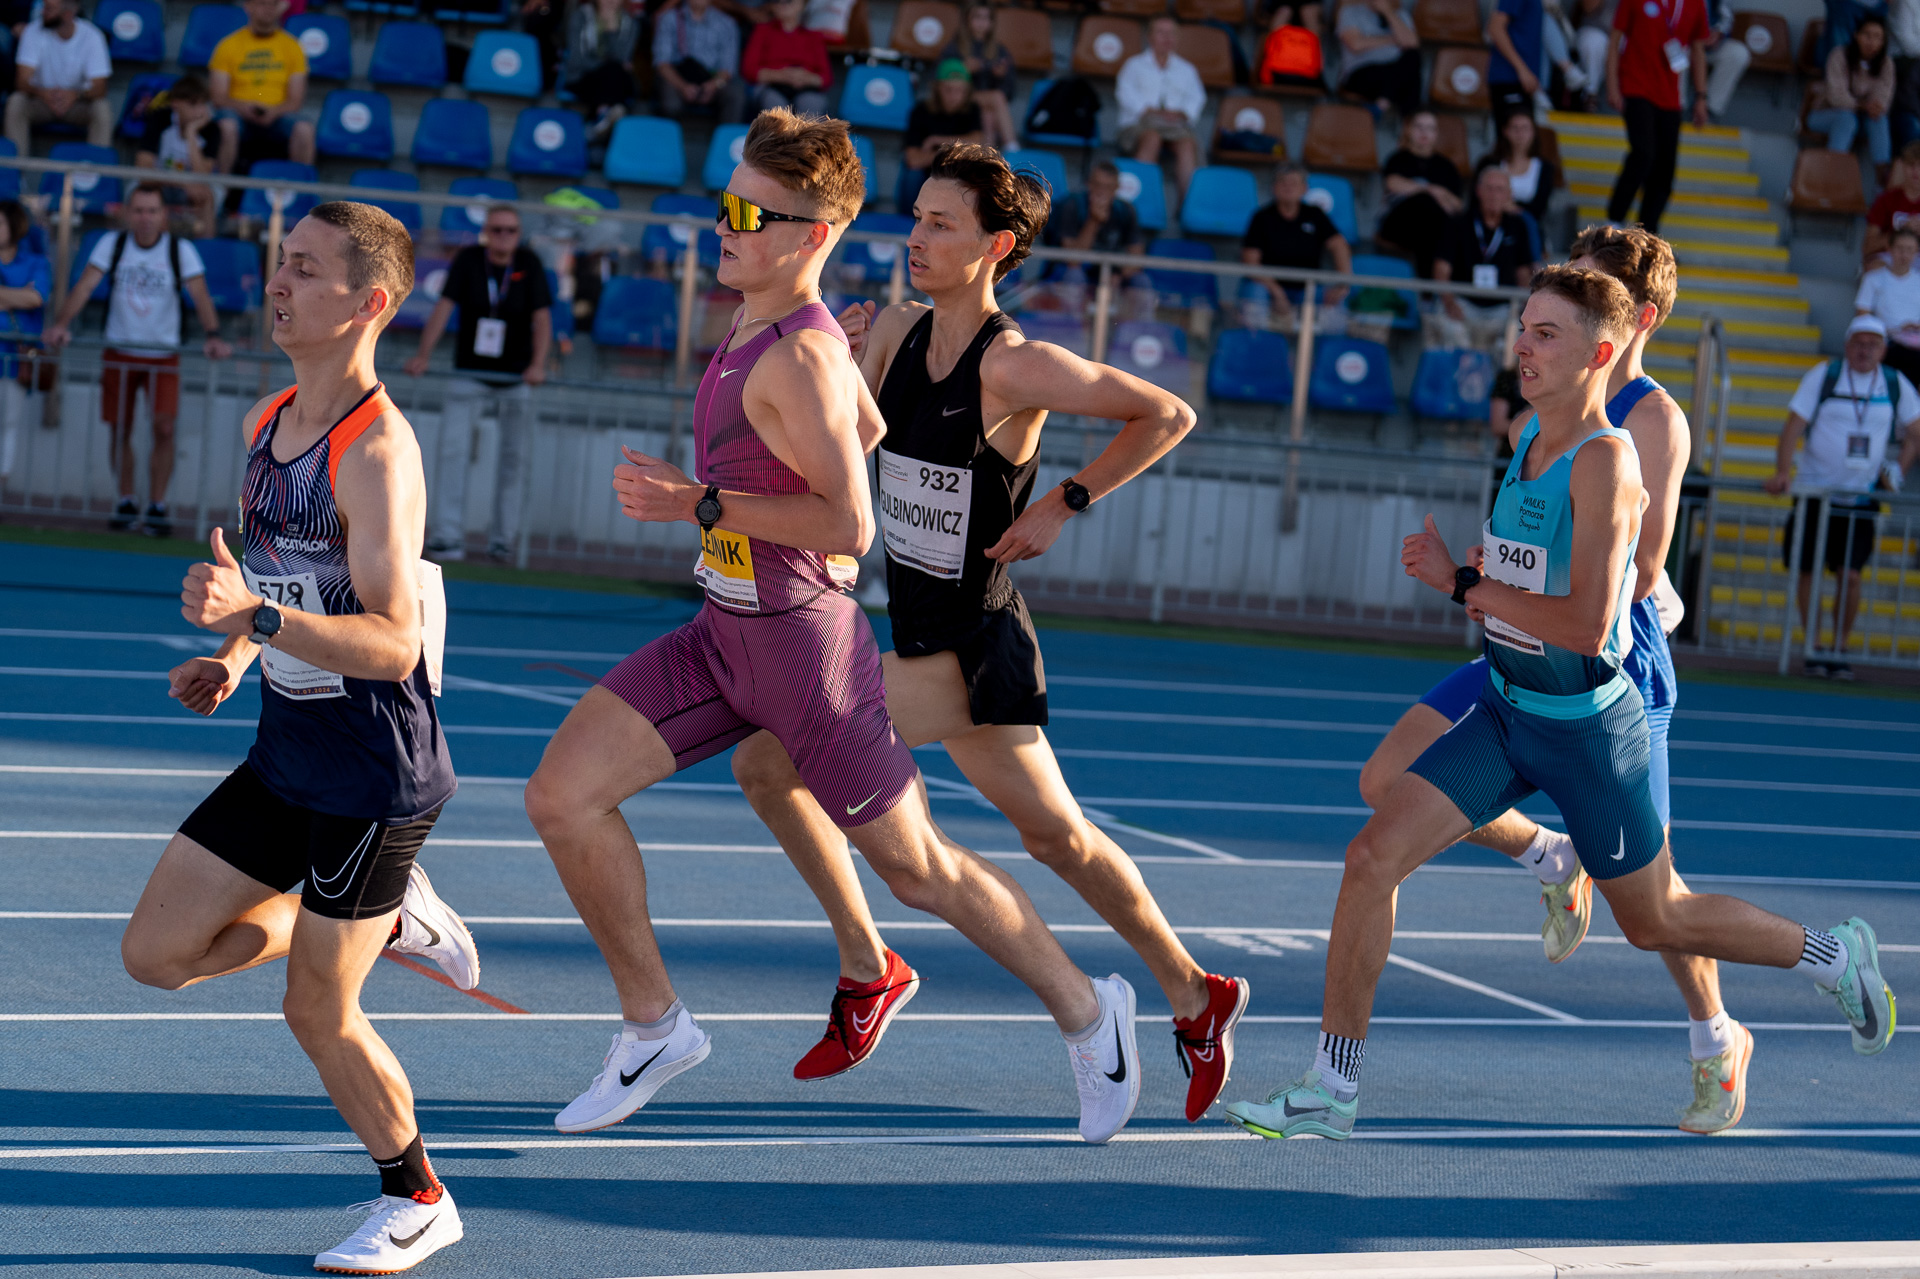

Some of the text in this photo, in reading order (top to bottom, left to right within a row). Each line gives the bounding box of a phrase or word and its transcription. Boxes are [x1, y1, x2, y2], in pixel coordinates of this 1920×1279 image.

[919, 466, 960, 494] 932
[1522, 495, 1546, 510] WMLKS
[1519, 506, 1544, 520] Pomorze
[275, 535, 329, 552] DECATHLON
[1498, 543, 1536, 570] 940
